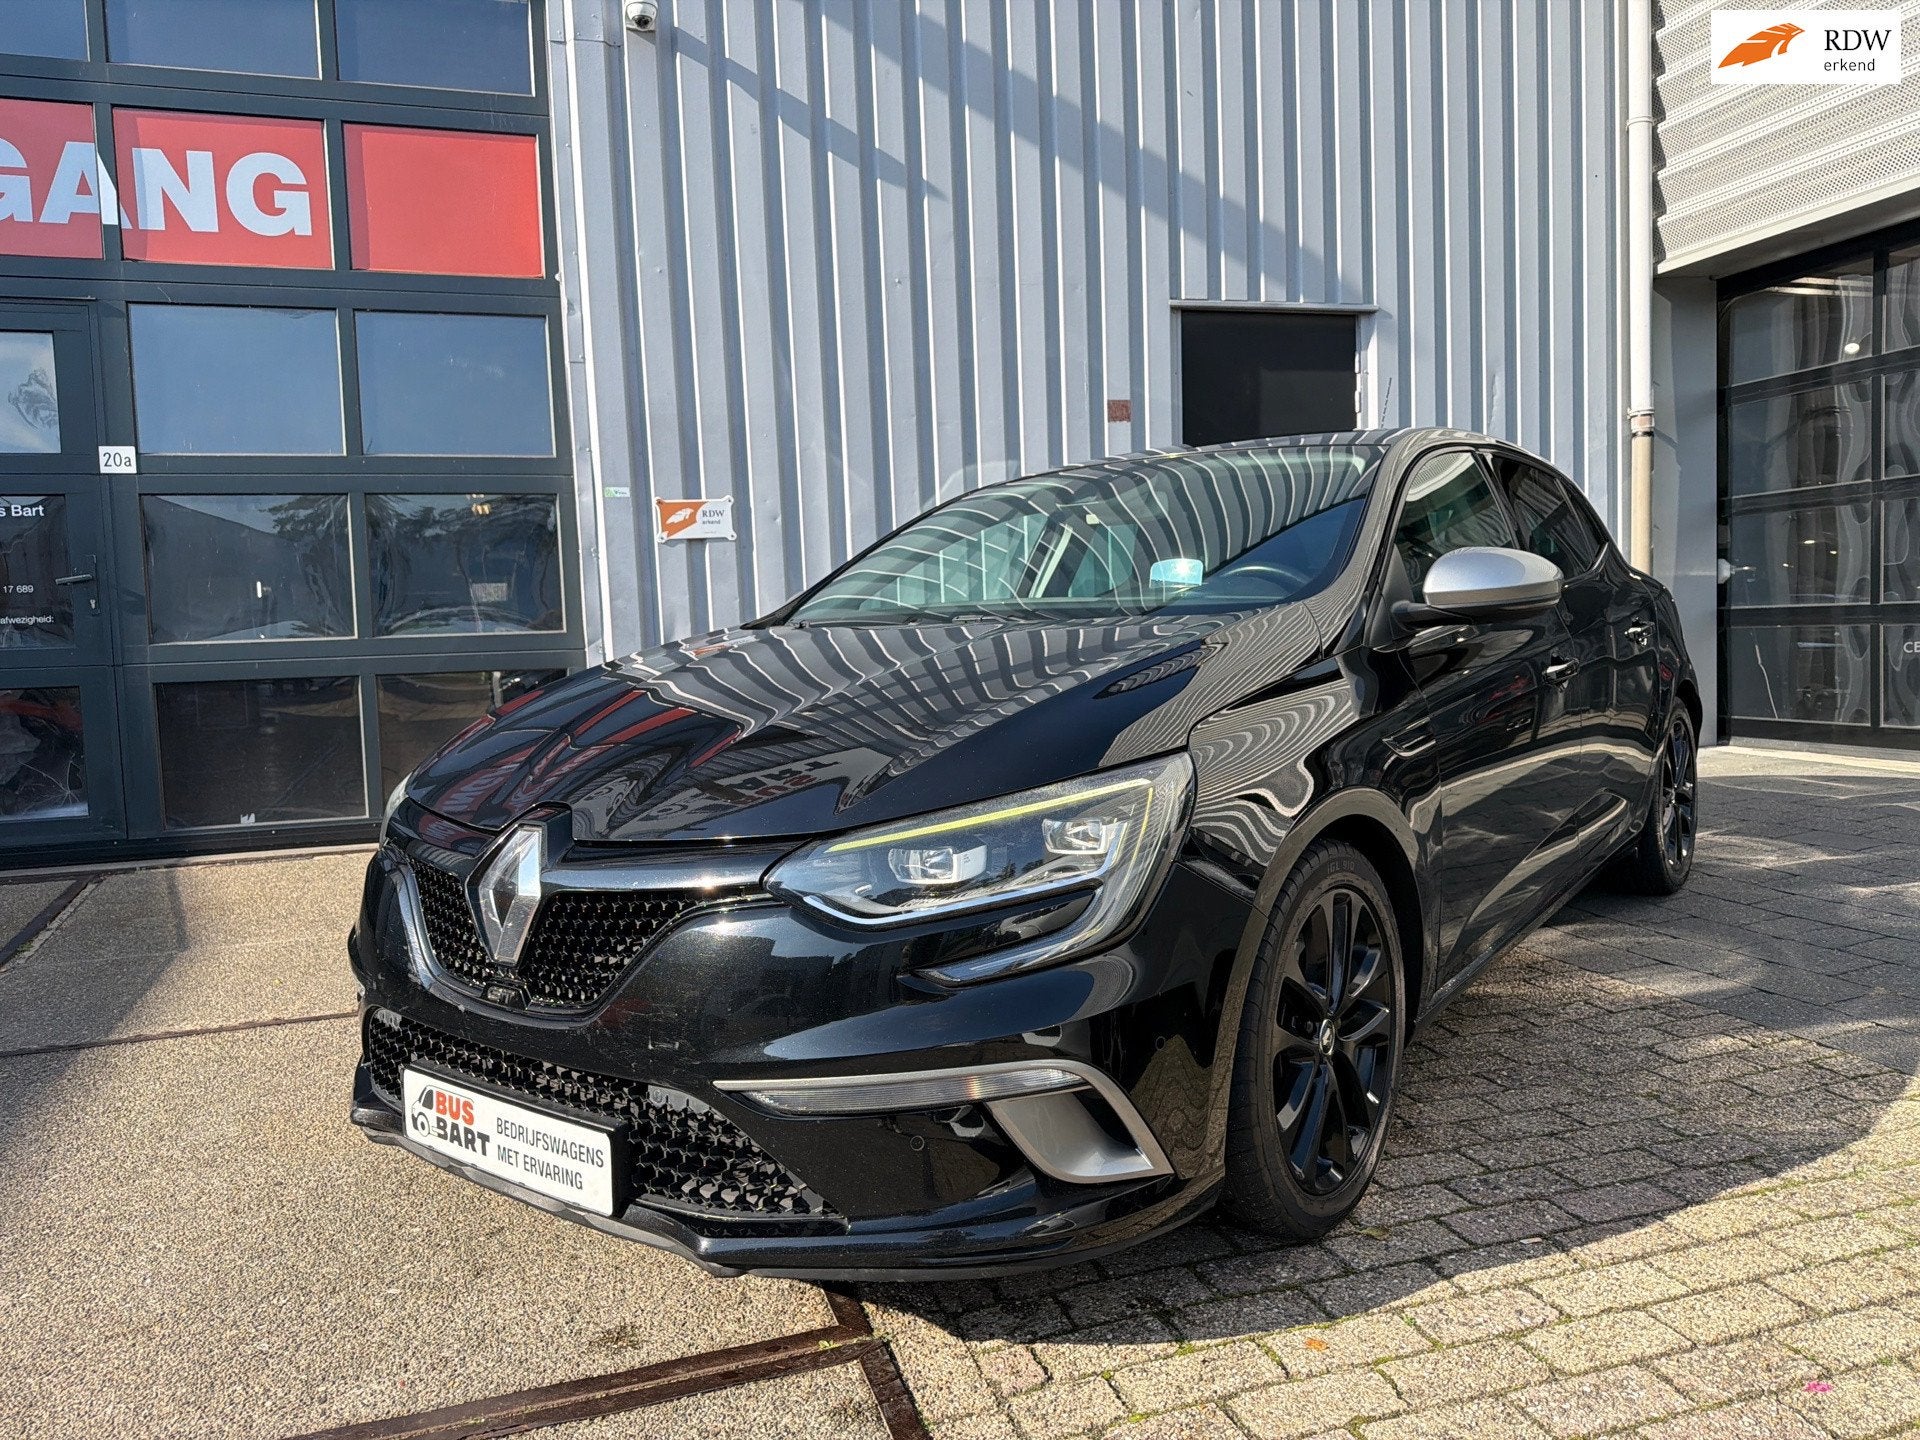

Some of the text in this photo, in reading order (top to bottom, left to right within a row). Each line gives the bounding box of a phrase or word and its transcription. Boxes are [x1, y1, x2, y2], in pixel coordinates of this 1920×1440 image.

[102, 452, 132, 467] 20a
[10, 504, 45, 517] Bart
[702, 509, 725, 518] RDW
[3, 584, 34, 594] 17 689
[435, 1090, 475, 1126] BUS
[435, 1116, 491, 1157] BART
[496, 1116, 604, 1168] BEDRIJFSWAGENS
[497, 1144, 584, 1190] MET ERVARING
